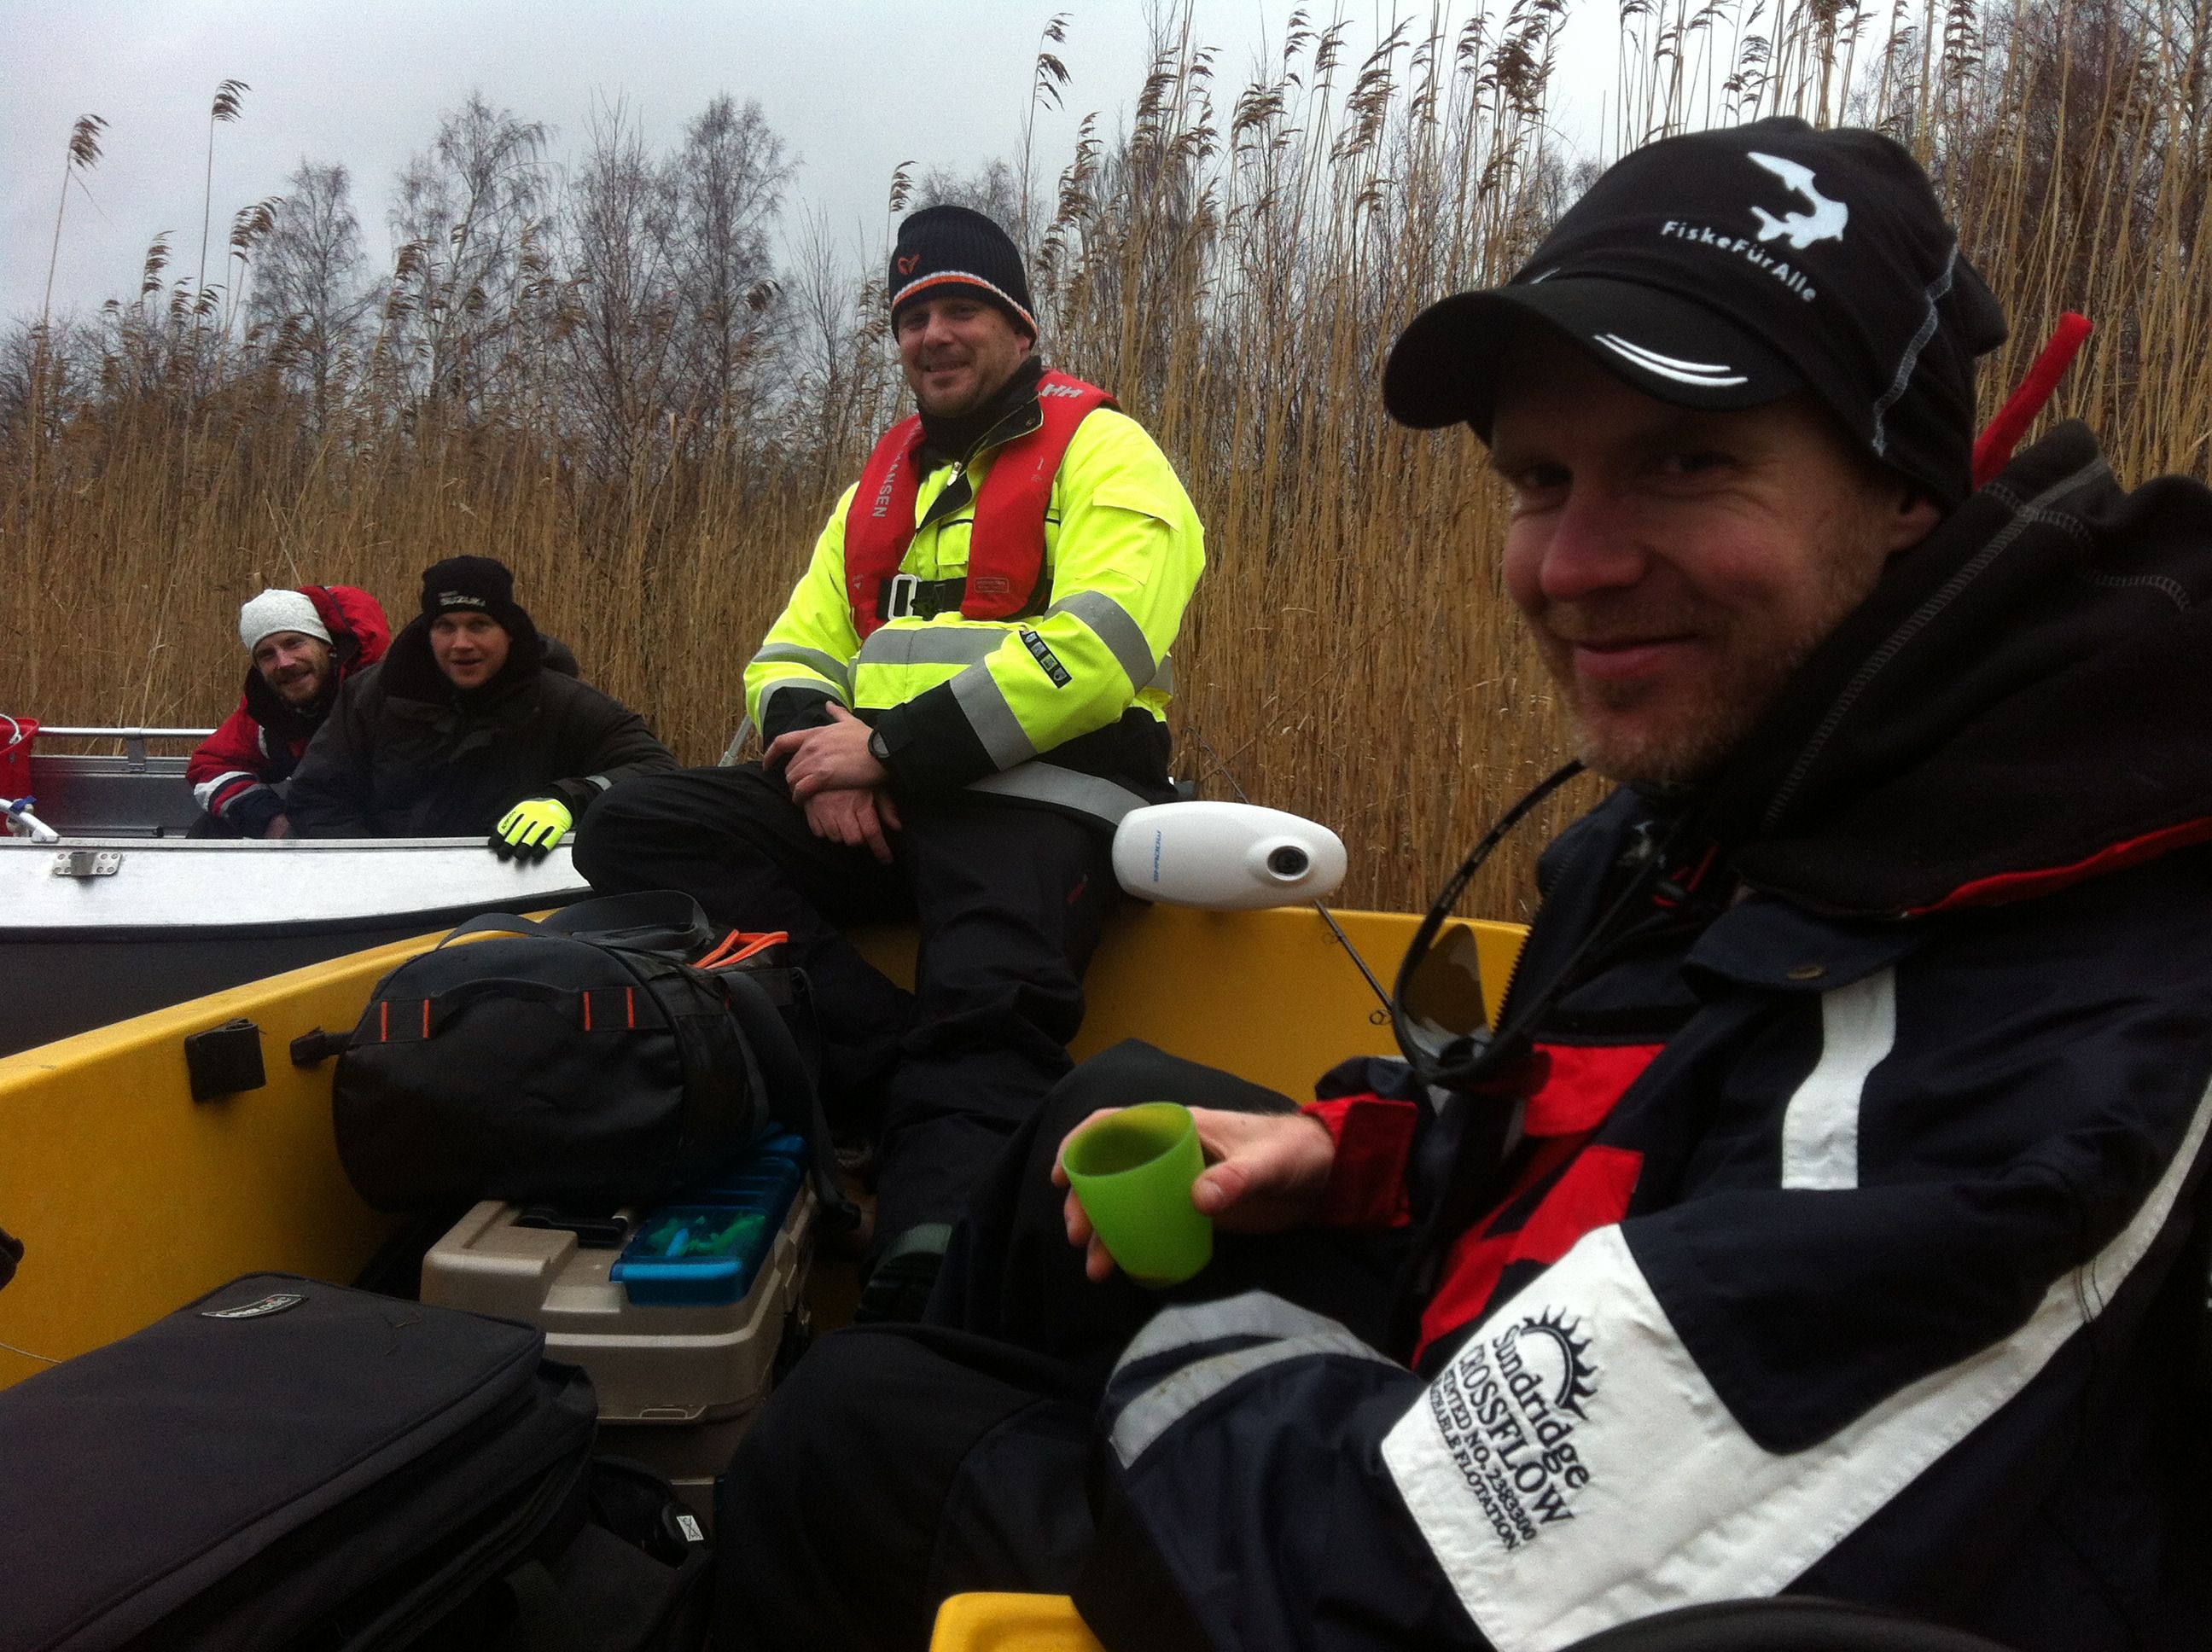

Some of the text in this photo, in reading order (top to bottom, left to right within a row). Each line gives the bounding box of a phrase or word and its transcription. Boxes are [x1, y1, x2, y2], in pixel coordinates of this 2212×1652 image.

[1040, 383, 1084, 398] HH
[1459, 1344, 1575, 1525] CROSSFLOW
[1464, 1430, 1492, 1471] NO.
[1492, 1324, 1590, 1489] Sundridge
[1454, 1449, 1519, 1551] FLOTATION
